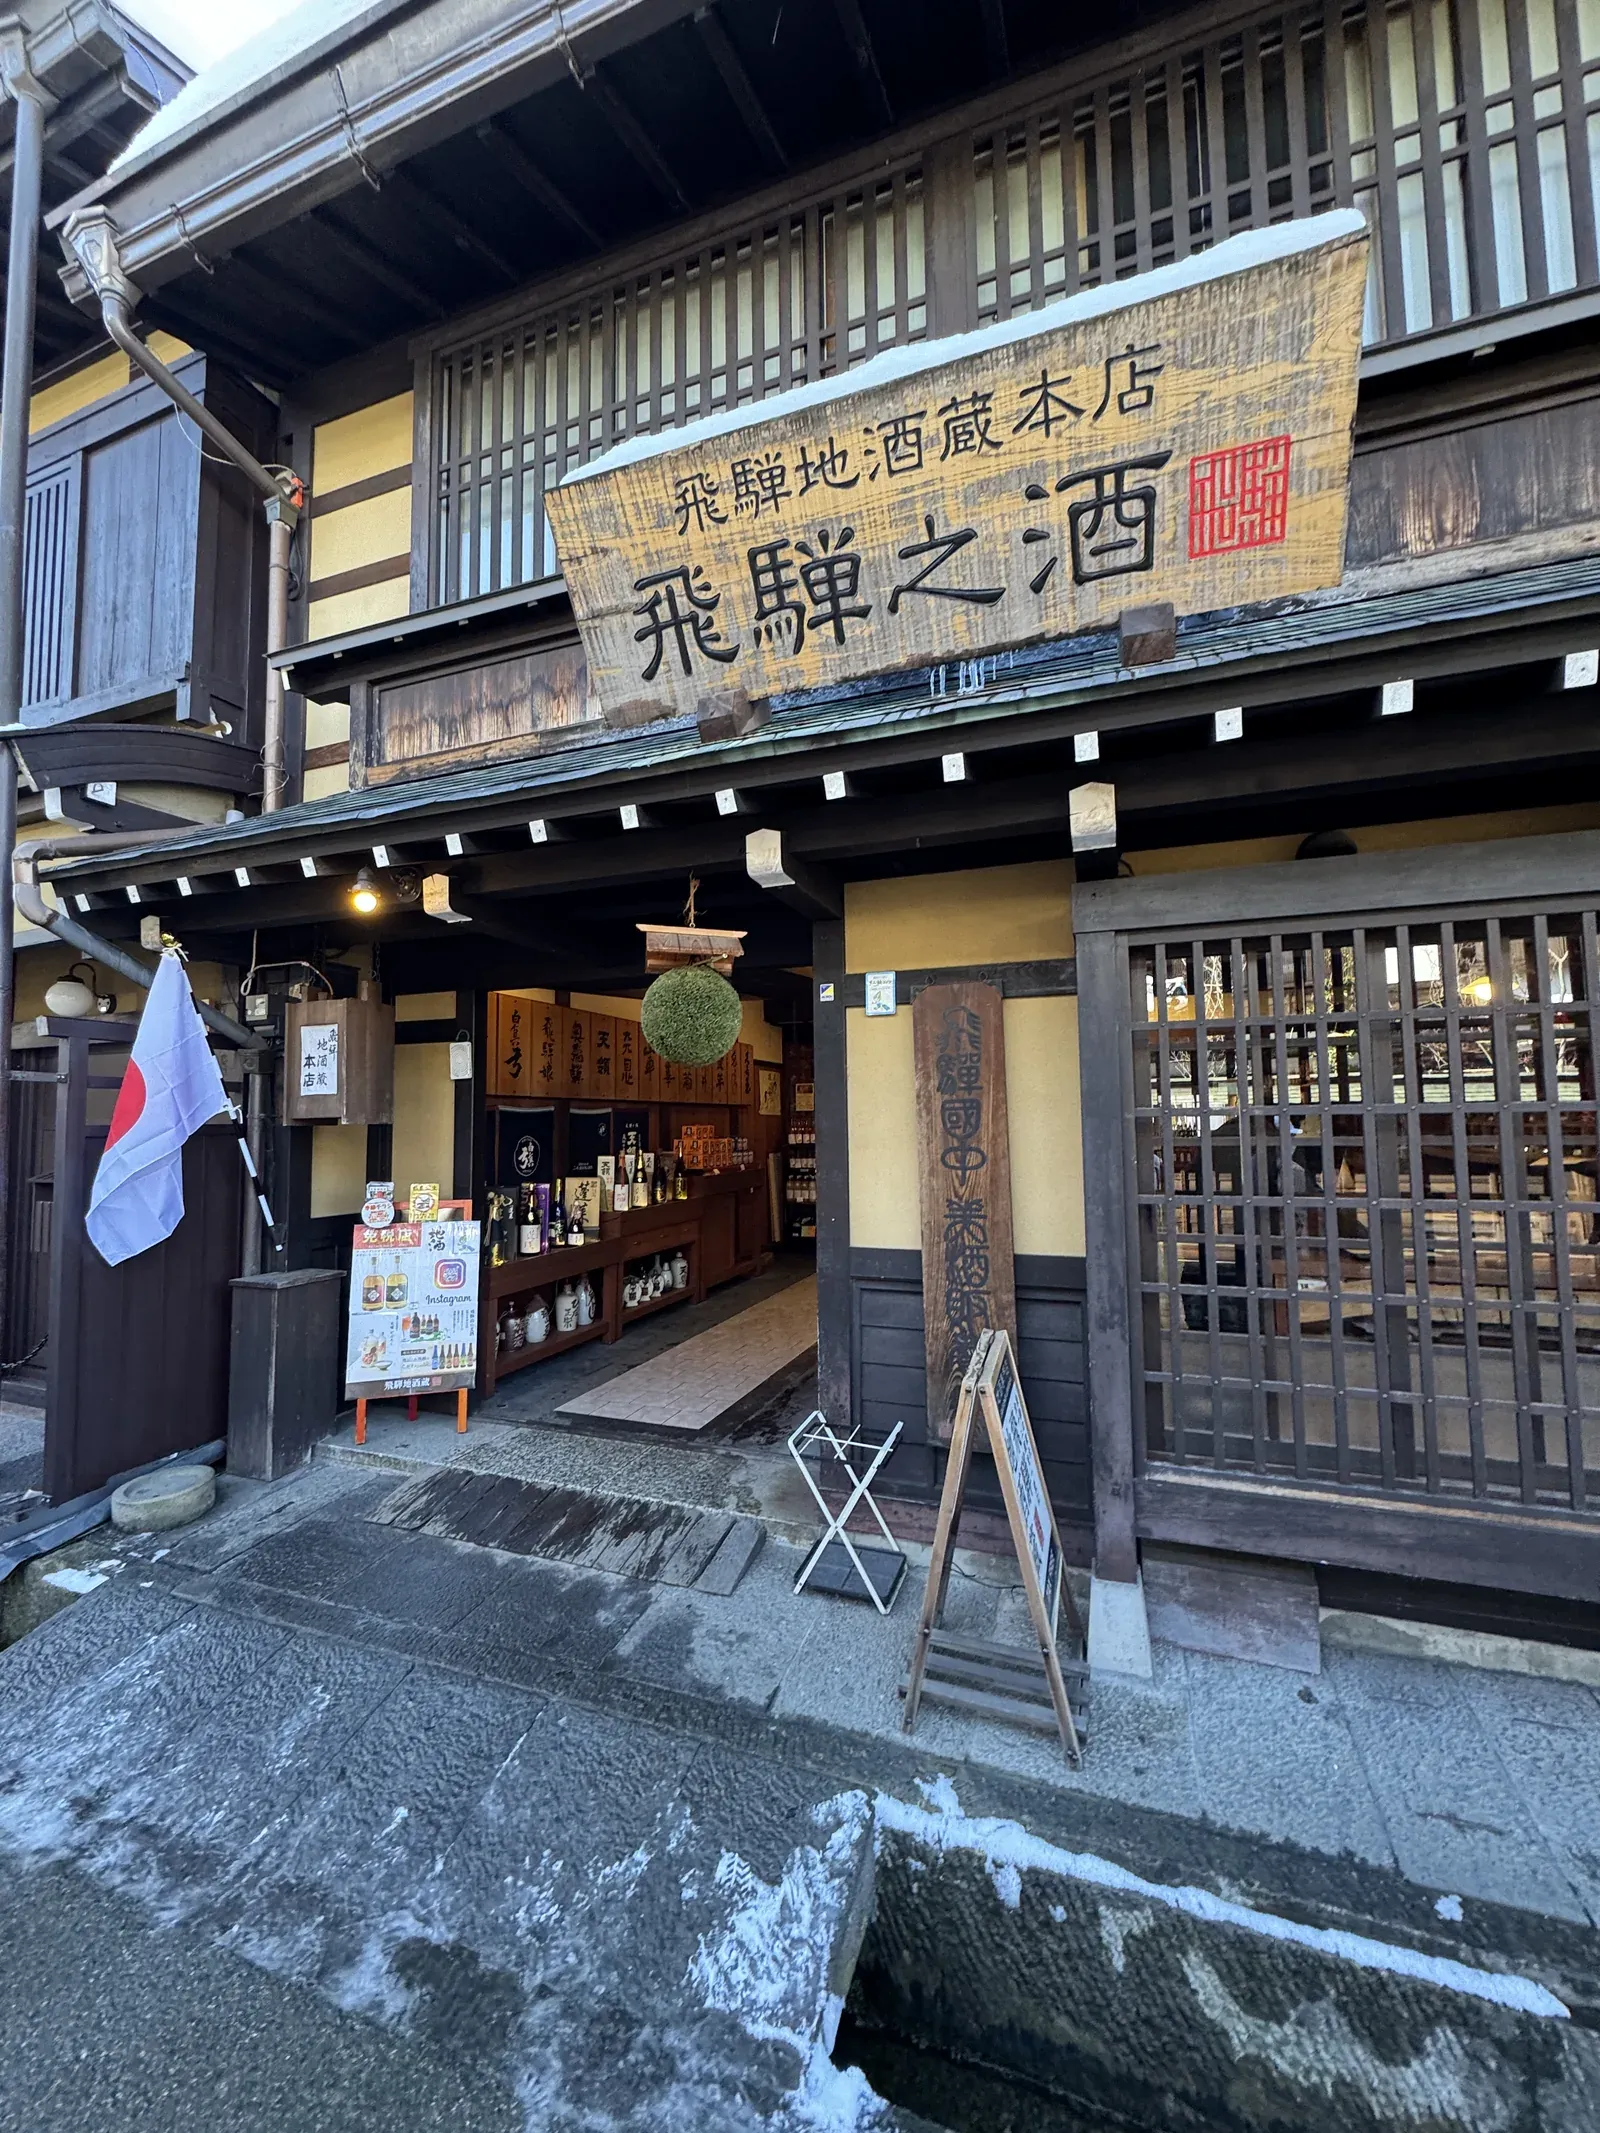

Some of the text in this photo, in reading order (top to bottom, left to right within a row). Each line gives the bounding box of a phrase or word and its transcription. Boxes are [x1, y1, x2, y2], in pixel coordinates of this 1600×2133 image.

[673, 343, 1166, 536] 飛騨地酒蔵本店
[632, 449, 1174, 681] 飛騨之酒
[303, 1053, 317, 1088] 本店
[427, 1225, 446, 1252] 地酒
[425, 1293, 472, 1307] Instagram
